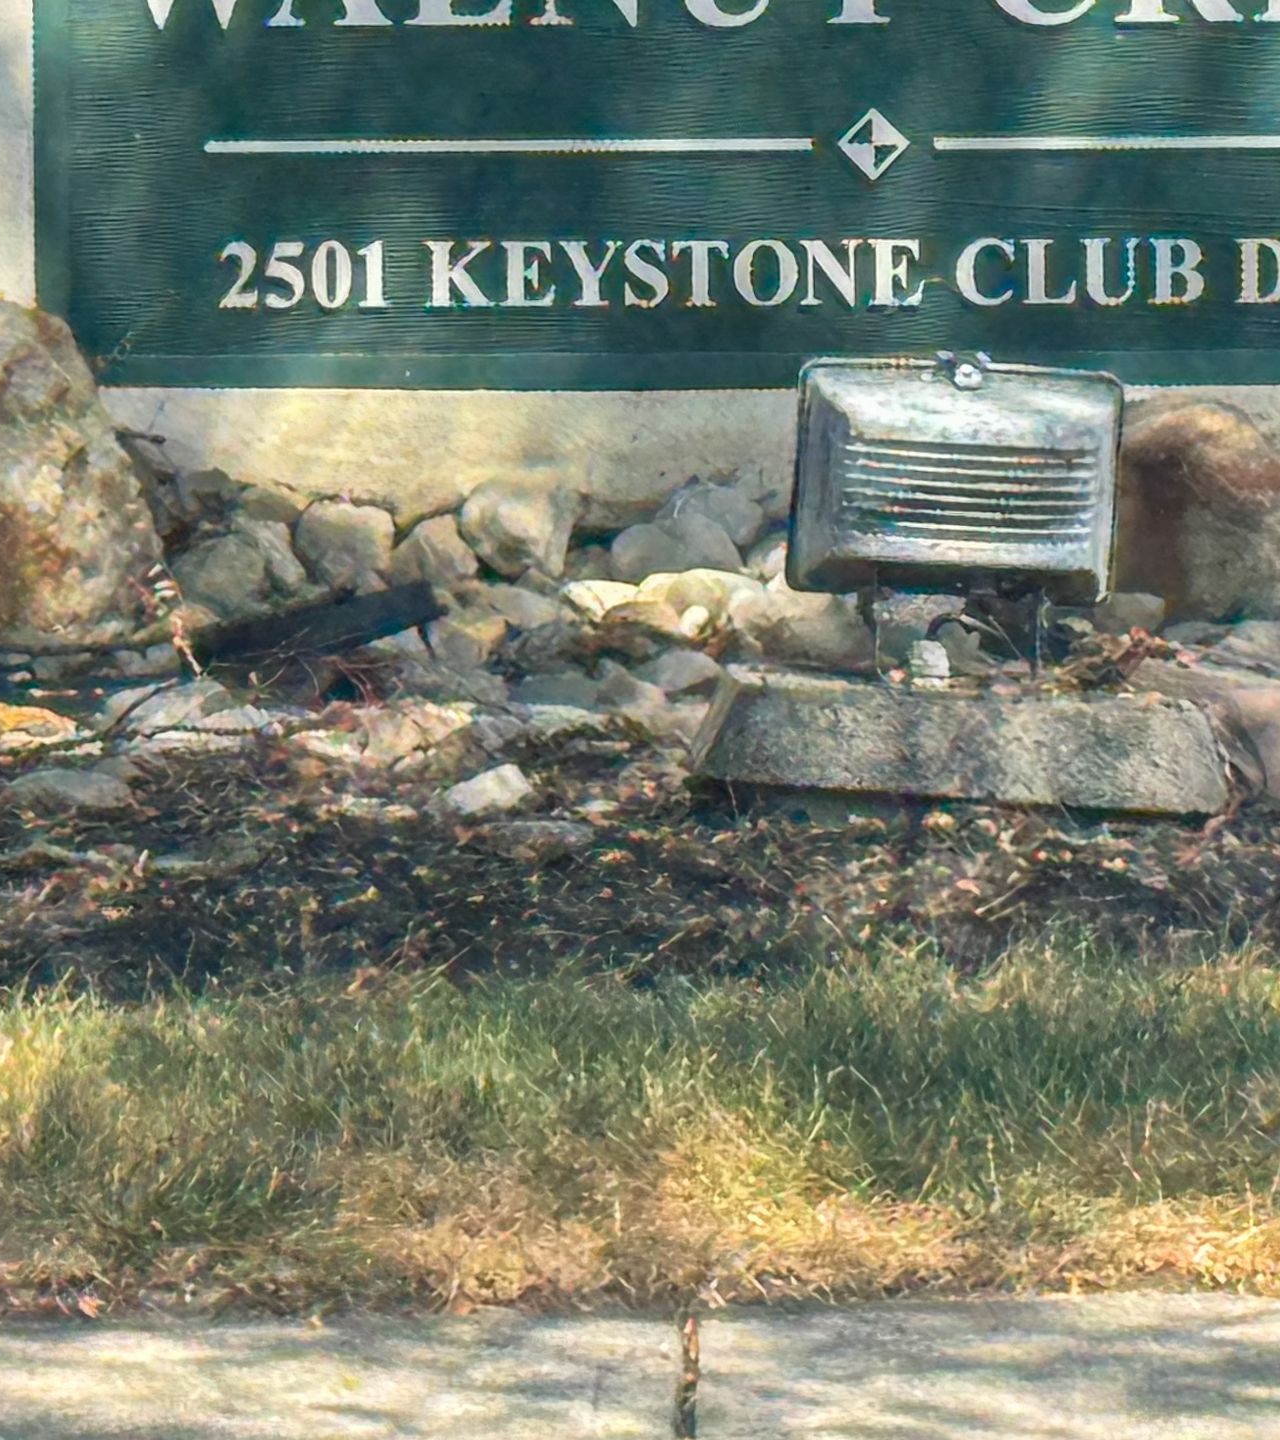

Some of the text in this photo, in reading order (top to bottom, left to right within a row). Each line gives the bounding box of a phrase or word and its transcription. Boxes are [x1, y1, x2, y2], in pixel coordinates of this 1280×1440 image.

[217, 240, 395, 310] 2501
[421, 239, 927, 309] KEYSTONE
[954, 237, 1206, 307] CLUB
